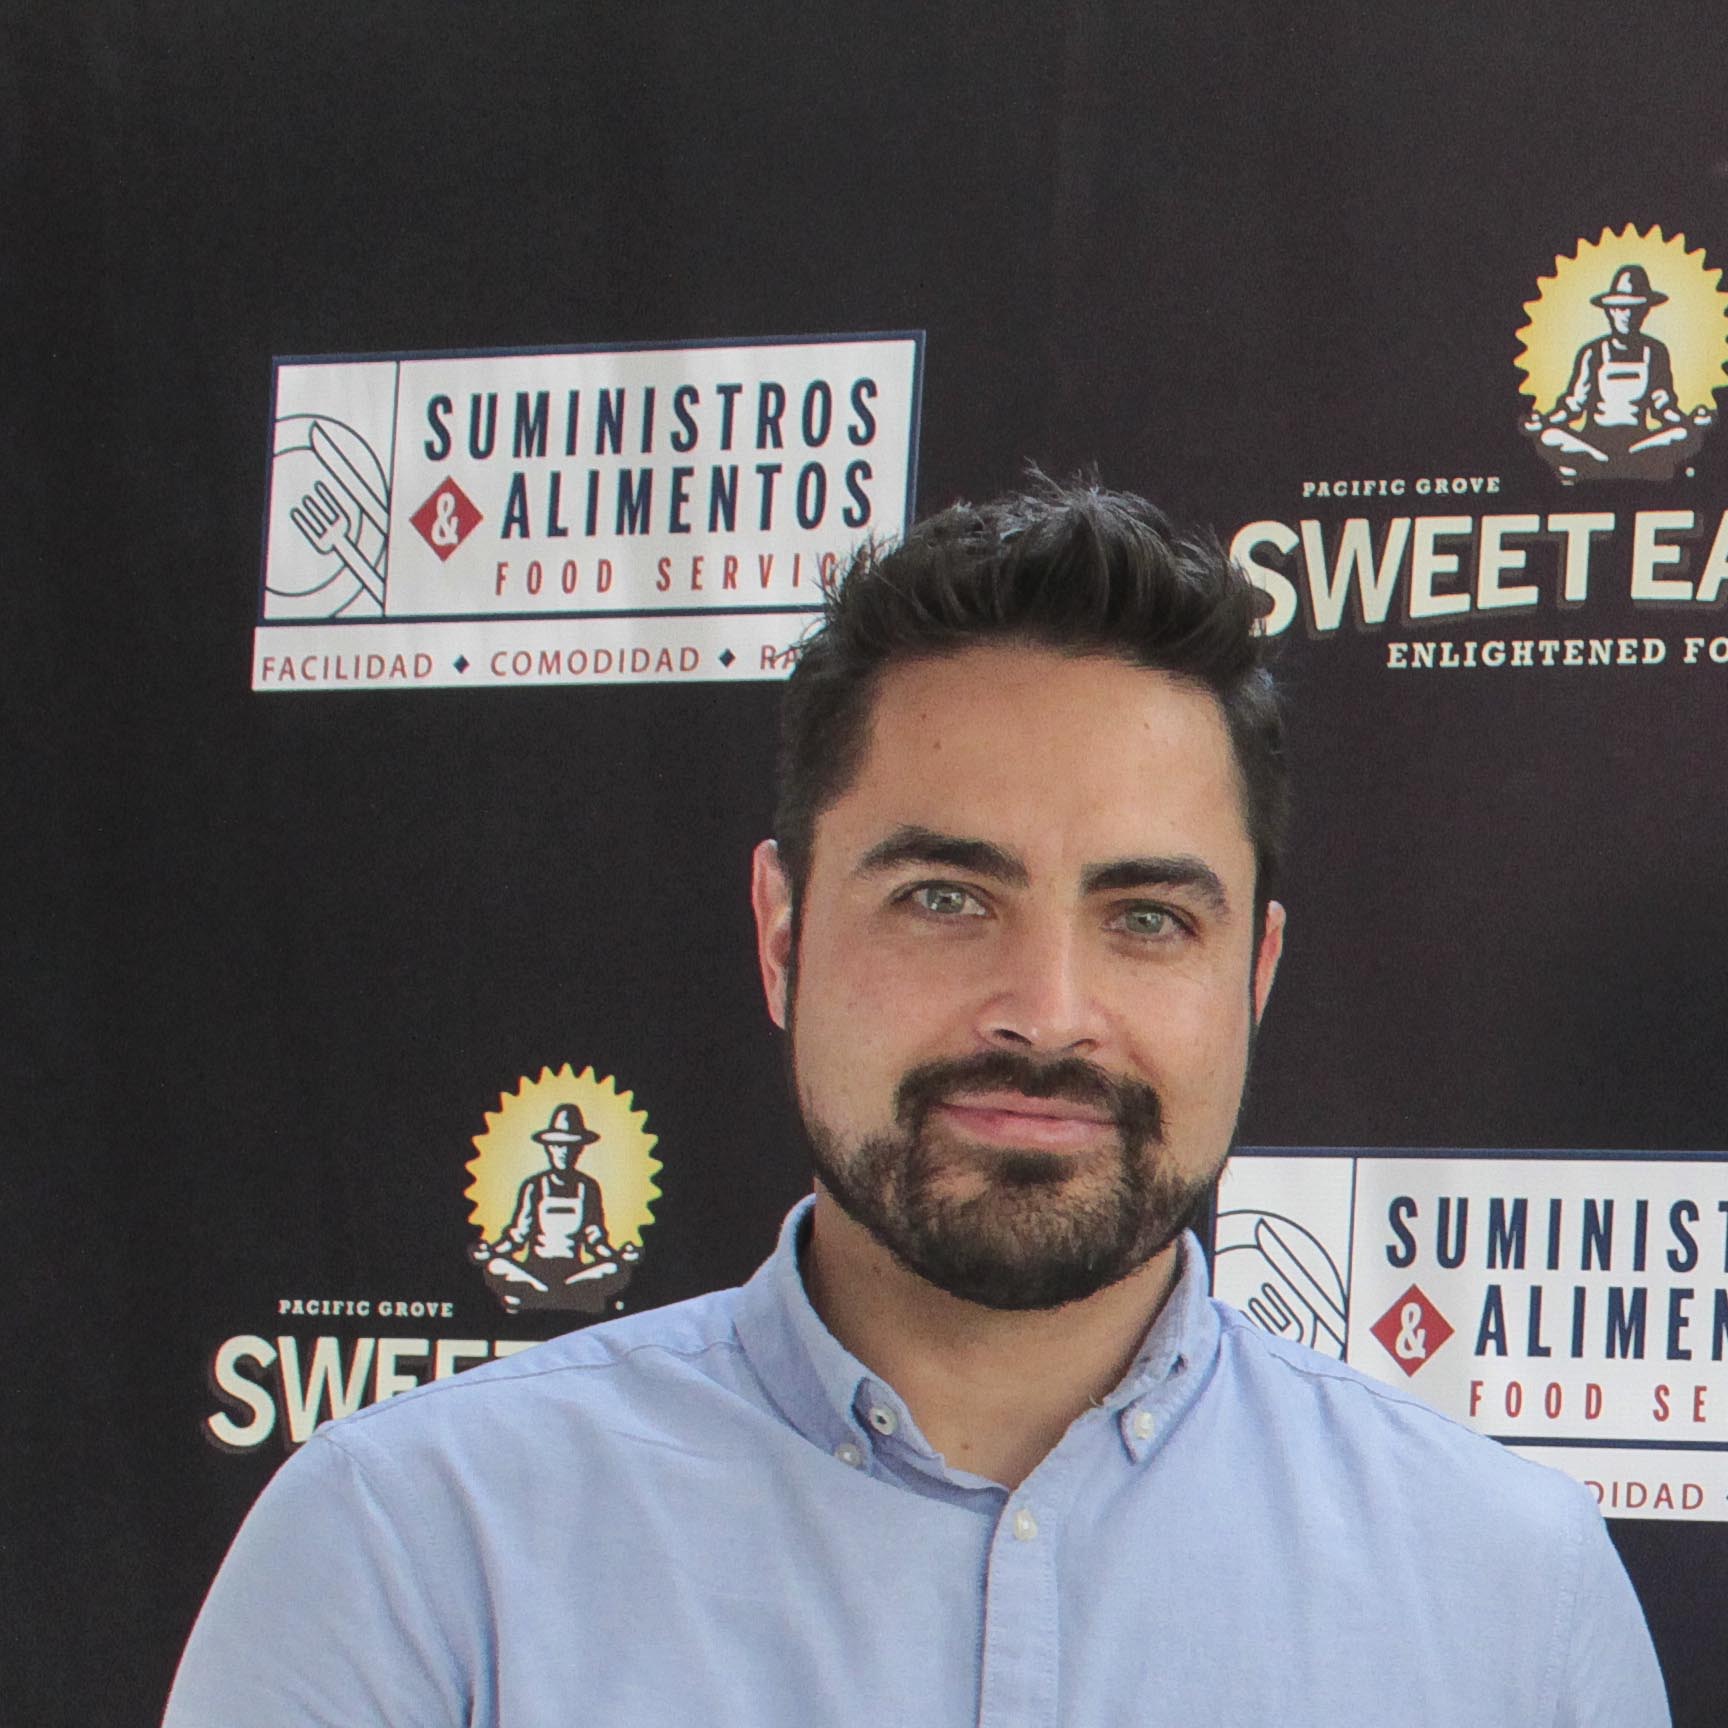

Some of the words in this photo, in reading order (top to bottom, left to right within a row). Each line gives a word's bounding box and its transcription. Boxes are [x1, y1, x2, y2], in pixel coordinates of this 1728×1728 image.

[424, 377, 879, 461] SUMINISTROS
[431, 493, 458, 546] &
[501, 460, 874, 539] ALIMENTOS
[1302, 480, 1405, 498] PACIFIC
[1416, 476, 1501, 496] GROVE
[496, 559, 613, 595] FOOD
[1229, 511, 1615, 637] SWEET
[261, 652, 433, 681] FACILIDAD
[491, 646, 700, 677] COMODIDAD
[1387, 638, 1667, 669] ENLIGHTENED
[279, 1300, 369, 1317] PACIFIC
[378, 1301, 454, 1318] GROVE
[1395, 1302, 1426, 1360] &
[1470, 1381, 1603, 1420] FOOD
